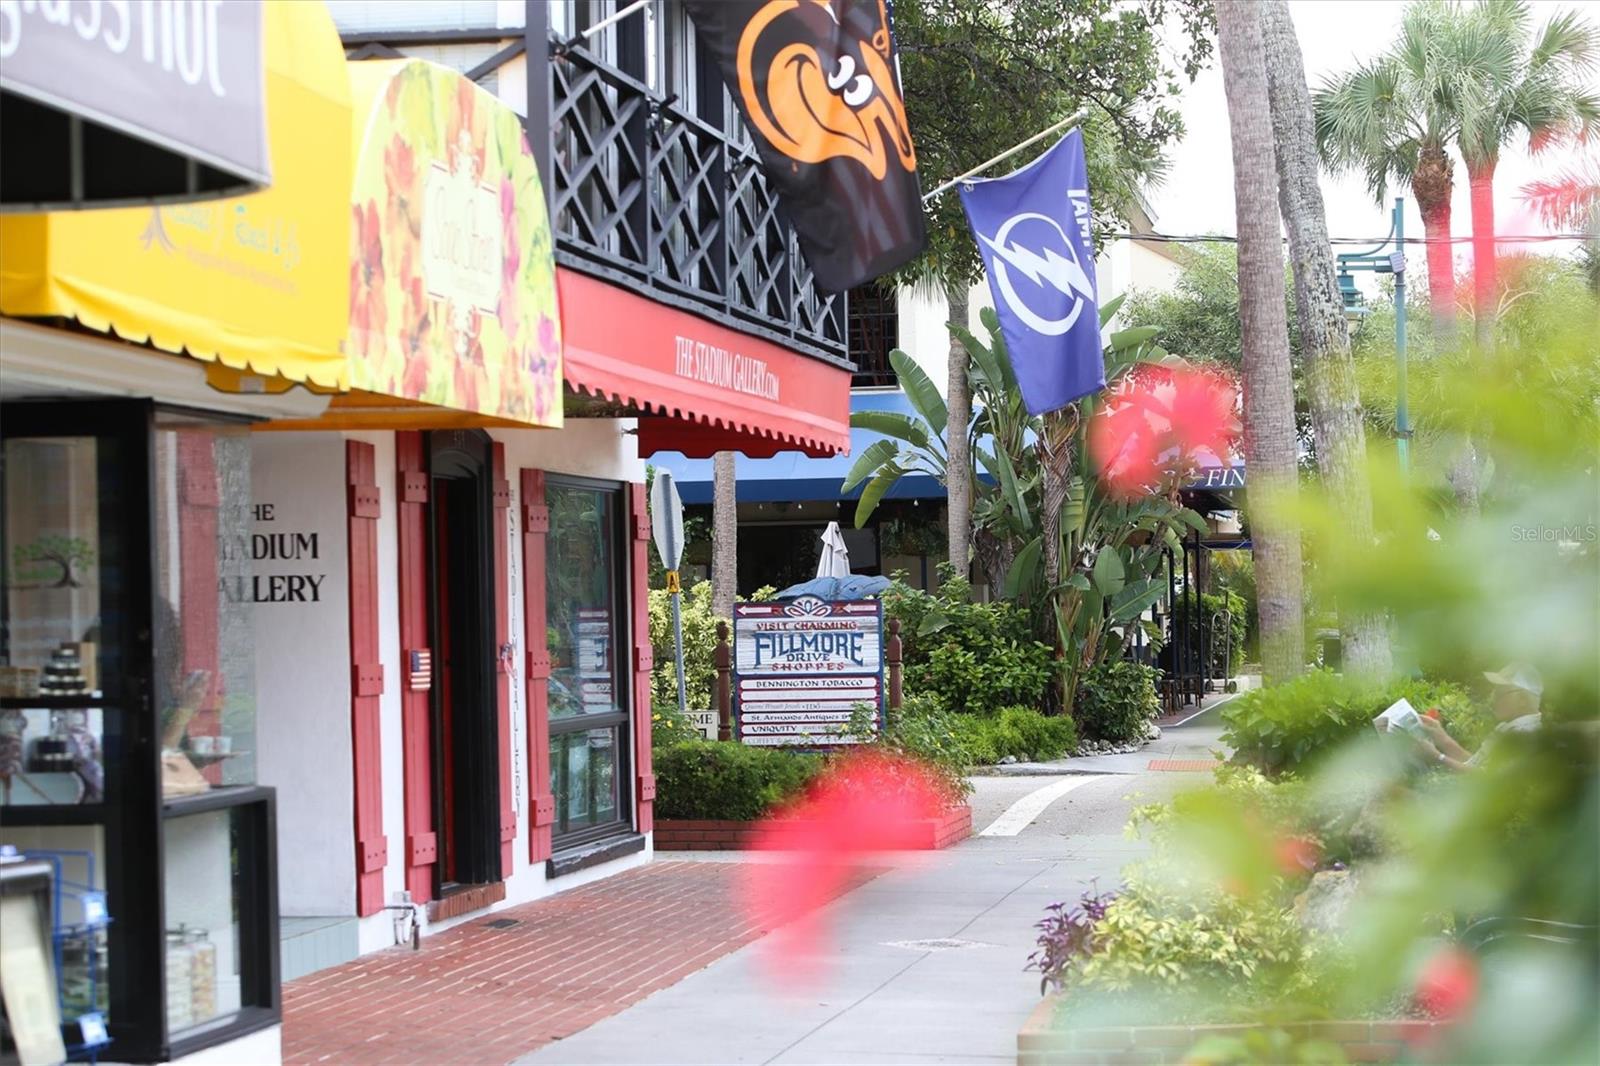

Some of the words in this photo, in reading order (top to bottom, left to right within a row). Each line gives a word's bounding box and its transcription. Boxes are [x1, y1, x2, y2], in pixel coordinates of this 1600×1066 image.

[675, 335, 694, 378] THE
[694, 341, 734, 389] STADIUM
[734, 353, 780, 401] GALLERY.COM
[756, 621, 789, 631] VISIT
[794, 620, 858, 631] CHARMING
[752, 632, 865, 669] FILLMORE
[786, 652, 831, 662] DRIVE
[771, 662, 845, 672] SHOPPES
[756, 680, 819, 688] BENNINGTON
[820, 679, 863, 687] TOBACCO
[751, 725, 797, 733] UNIQUITY
